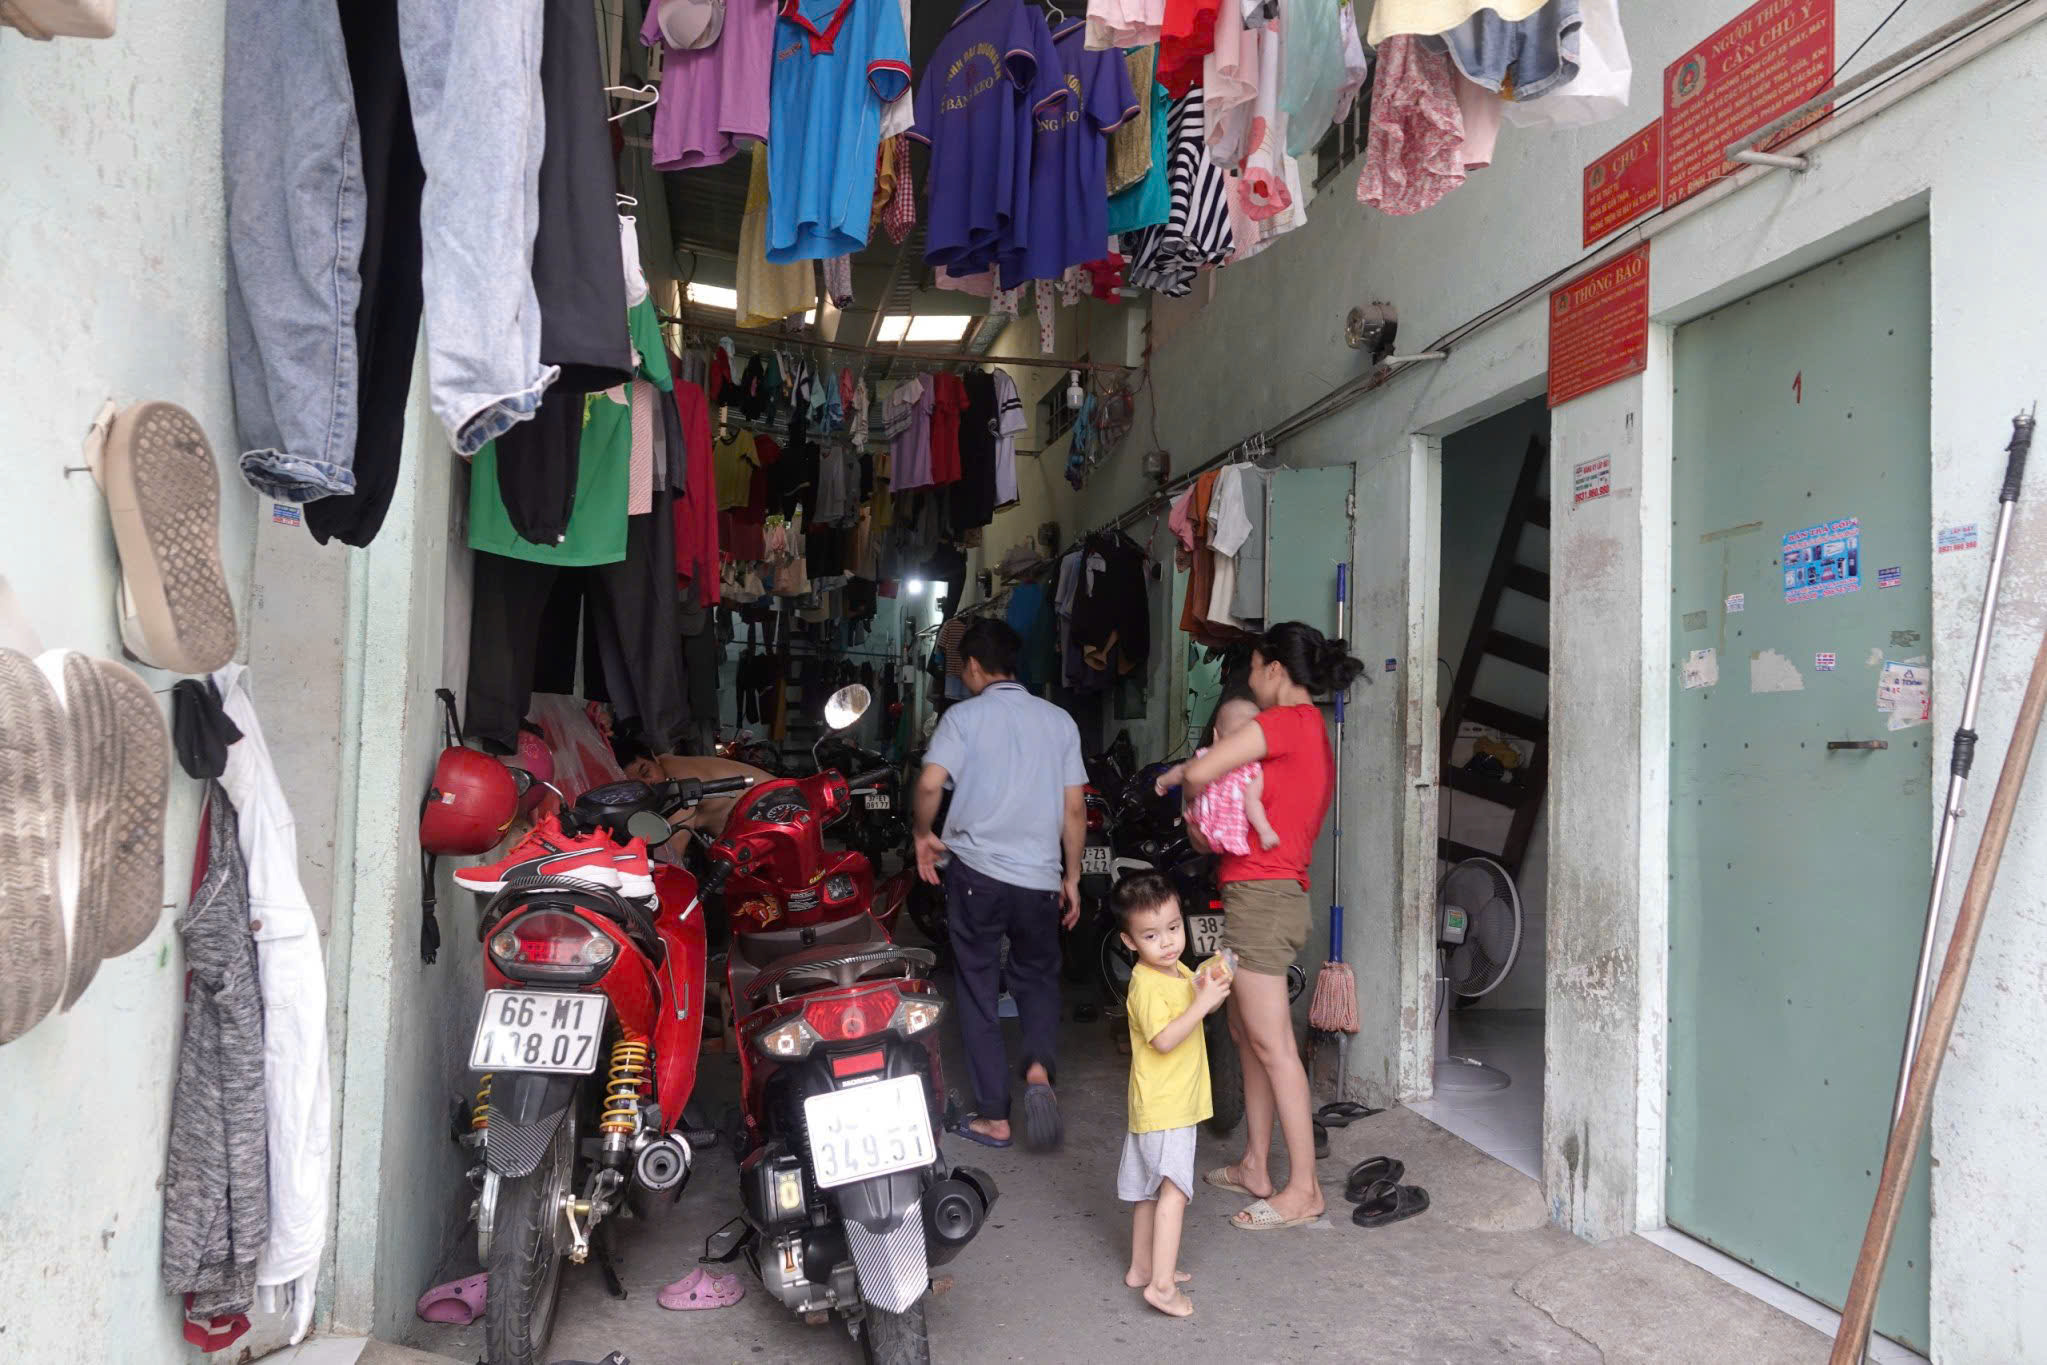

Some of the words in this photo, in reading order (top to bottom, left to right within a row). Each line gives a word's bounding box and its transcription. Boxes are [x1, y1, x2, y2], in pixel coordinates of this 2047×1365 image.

[1713, 21, 1752, 56] NGƯỜI
[1722, 43, 1755, 73] CẦN
[1760, 11, 1795, 48] CHÚ
[1574, 278, 1613, 305] THÔNG
[1615, 258, 1642, 283] BÁO
[1198, 935, 1224, 953] 12
[499, 996, 585, 1030] 66-M1
[841, 1074, 880, 1088] HONDA
